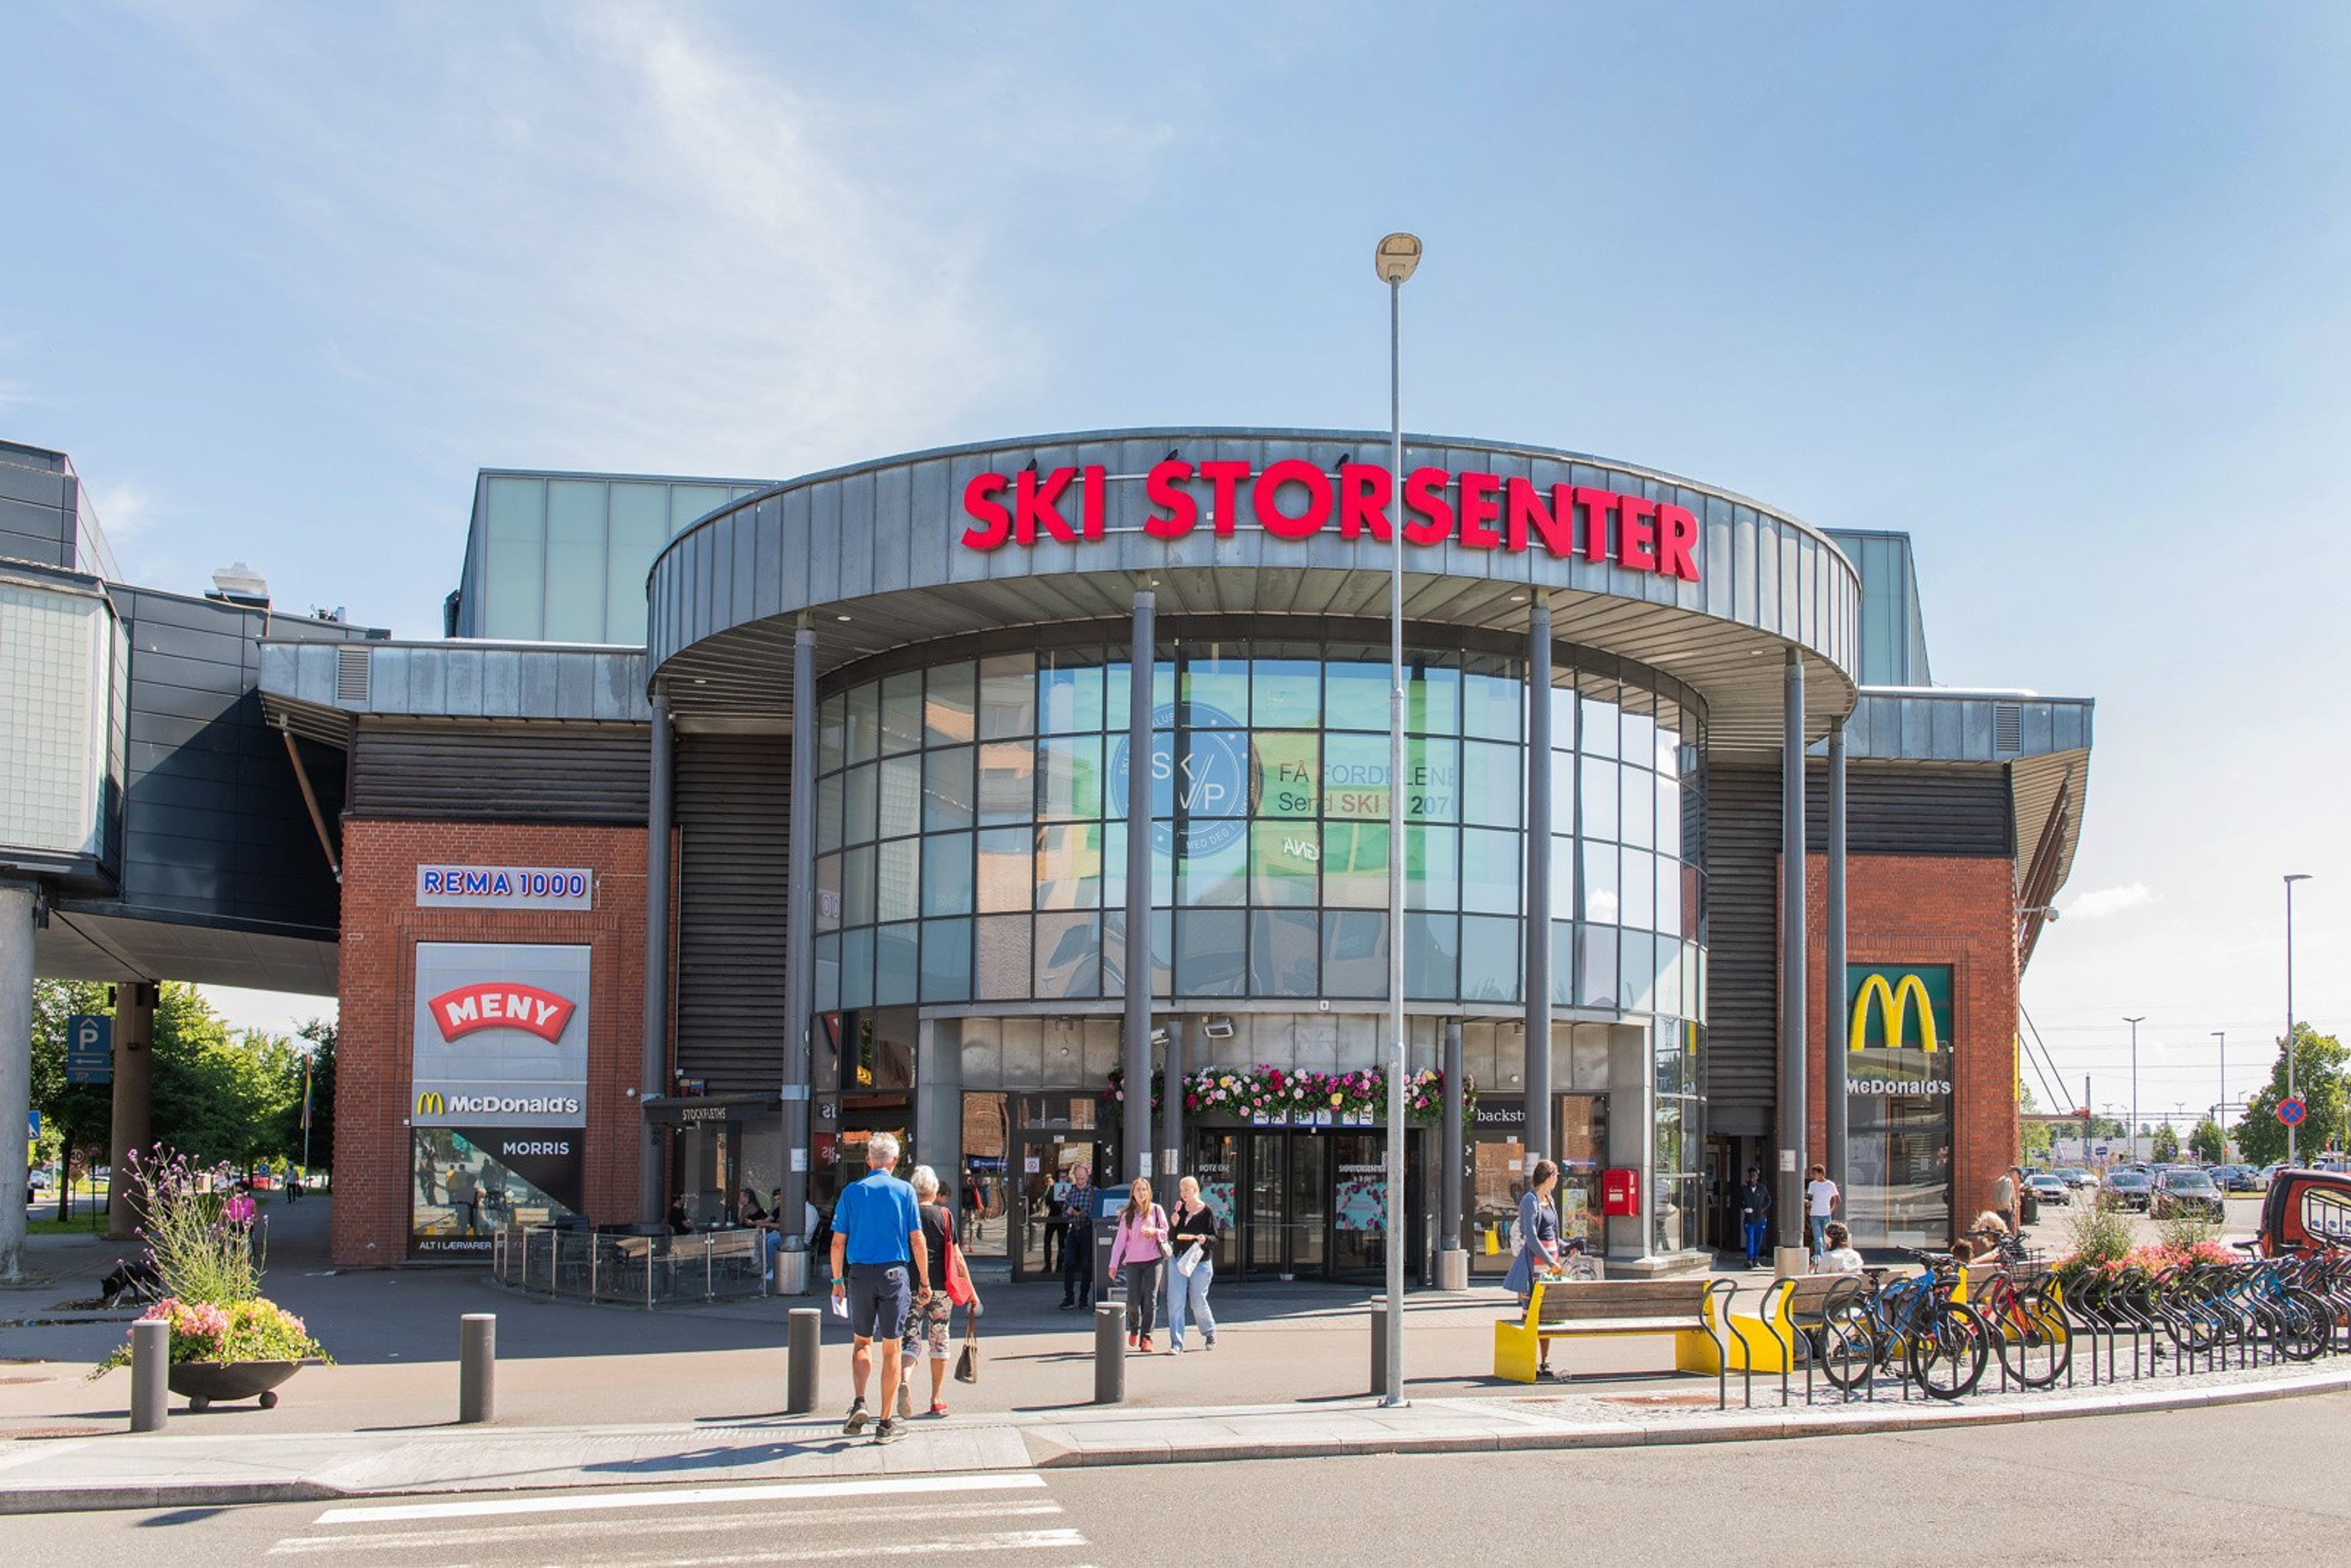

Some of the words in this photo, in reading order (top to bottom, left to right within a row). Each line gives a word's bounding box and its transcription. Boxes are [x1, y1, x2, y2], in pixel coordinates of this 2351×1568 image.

[961, 463, 1105, 551] SKI
[1144, 458, 1701, 582] STORSENTER
[1280, 760, 1309, 782] FÅ
[1341, 794, 1379, 813] SKI
[423, 871, 511, 895] REMA
[519, 872, 585, 897] 1000
[446, 993, 558, 1026] MENY
[79, 1029, 98, 1050] P
[1847, 1079, 1952, 1095] McDonald's
[449, 1095, 579, 1114] McDonald's
[503, 1141, 569, 1155] MORRIS
[419, 1241, 435, 1250] ALT
